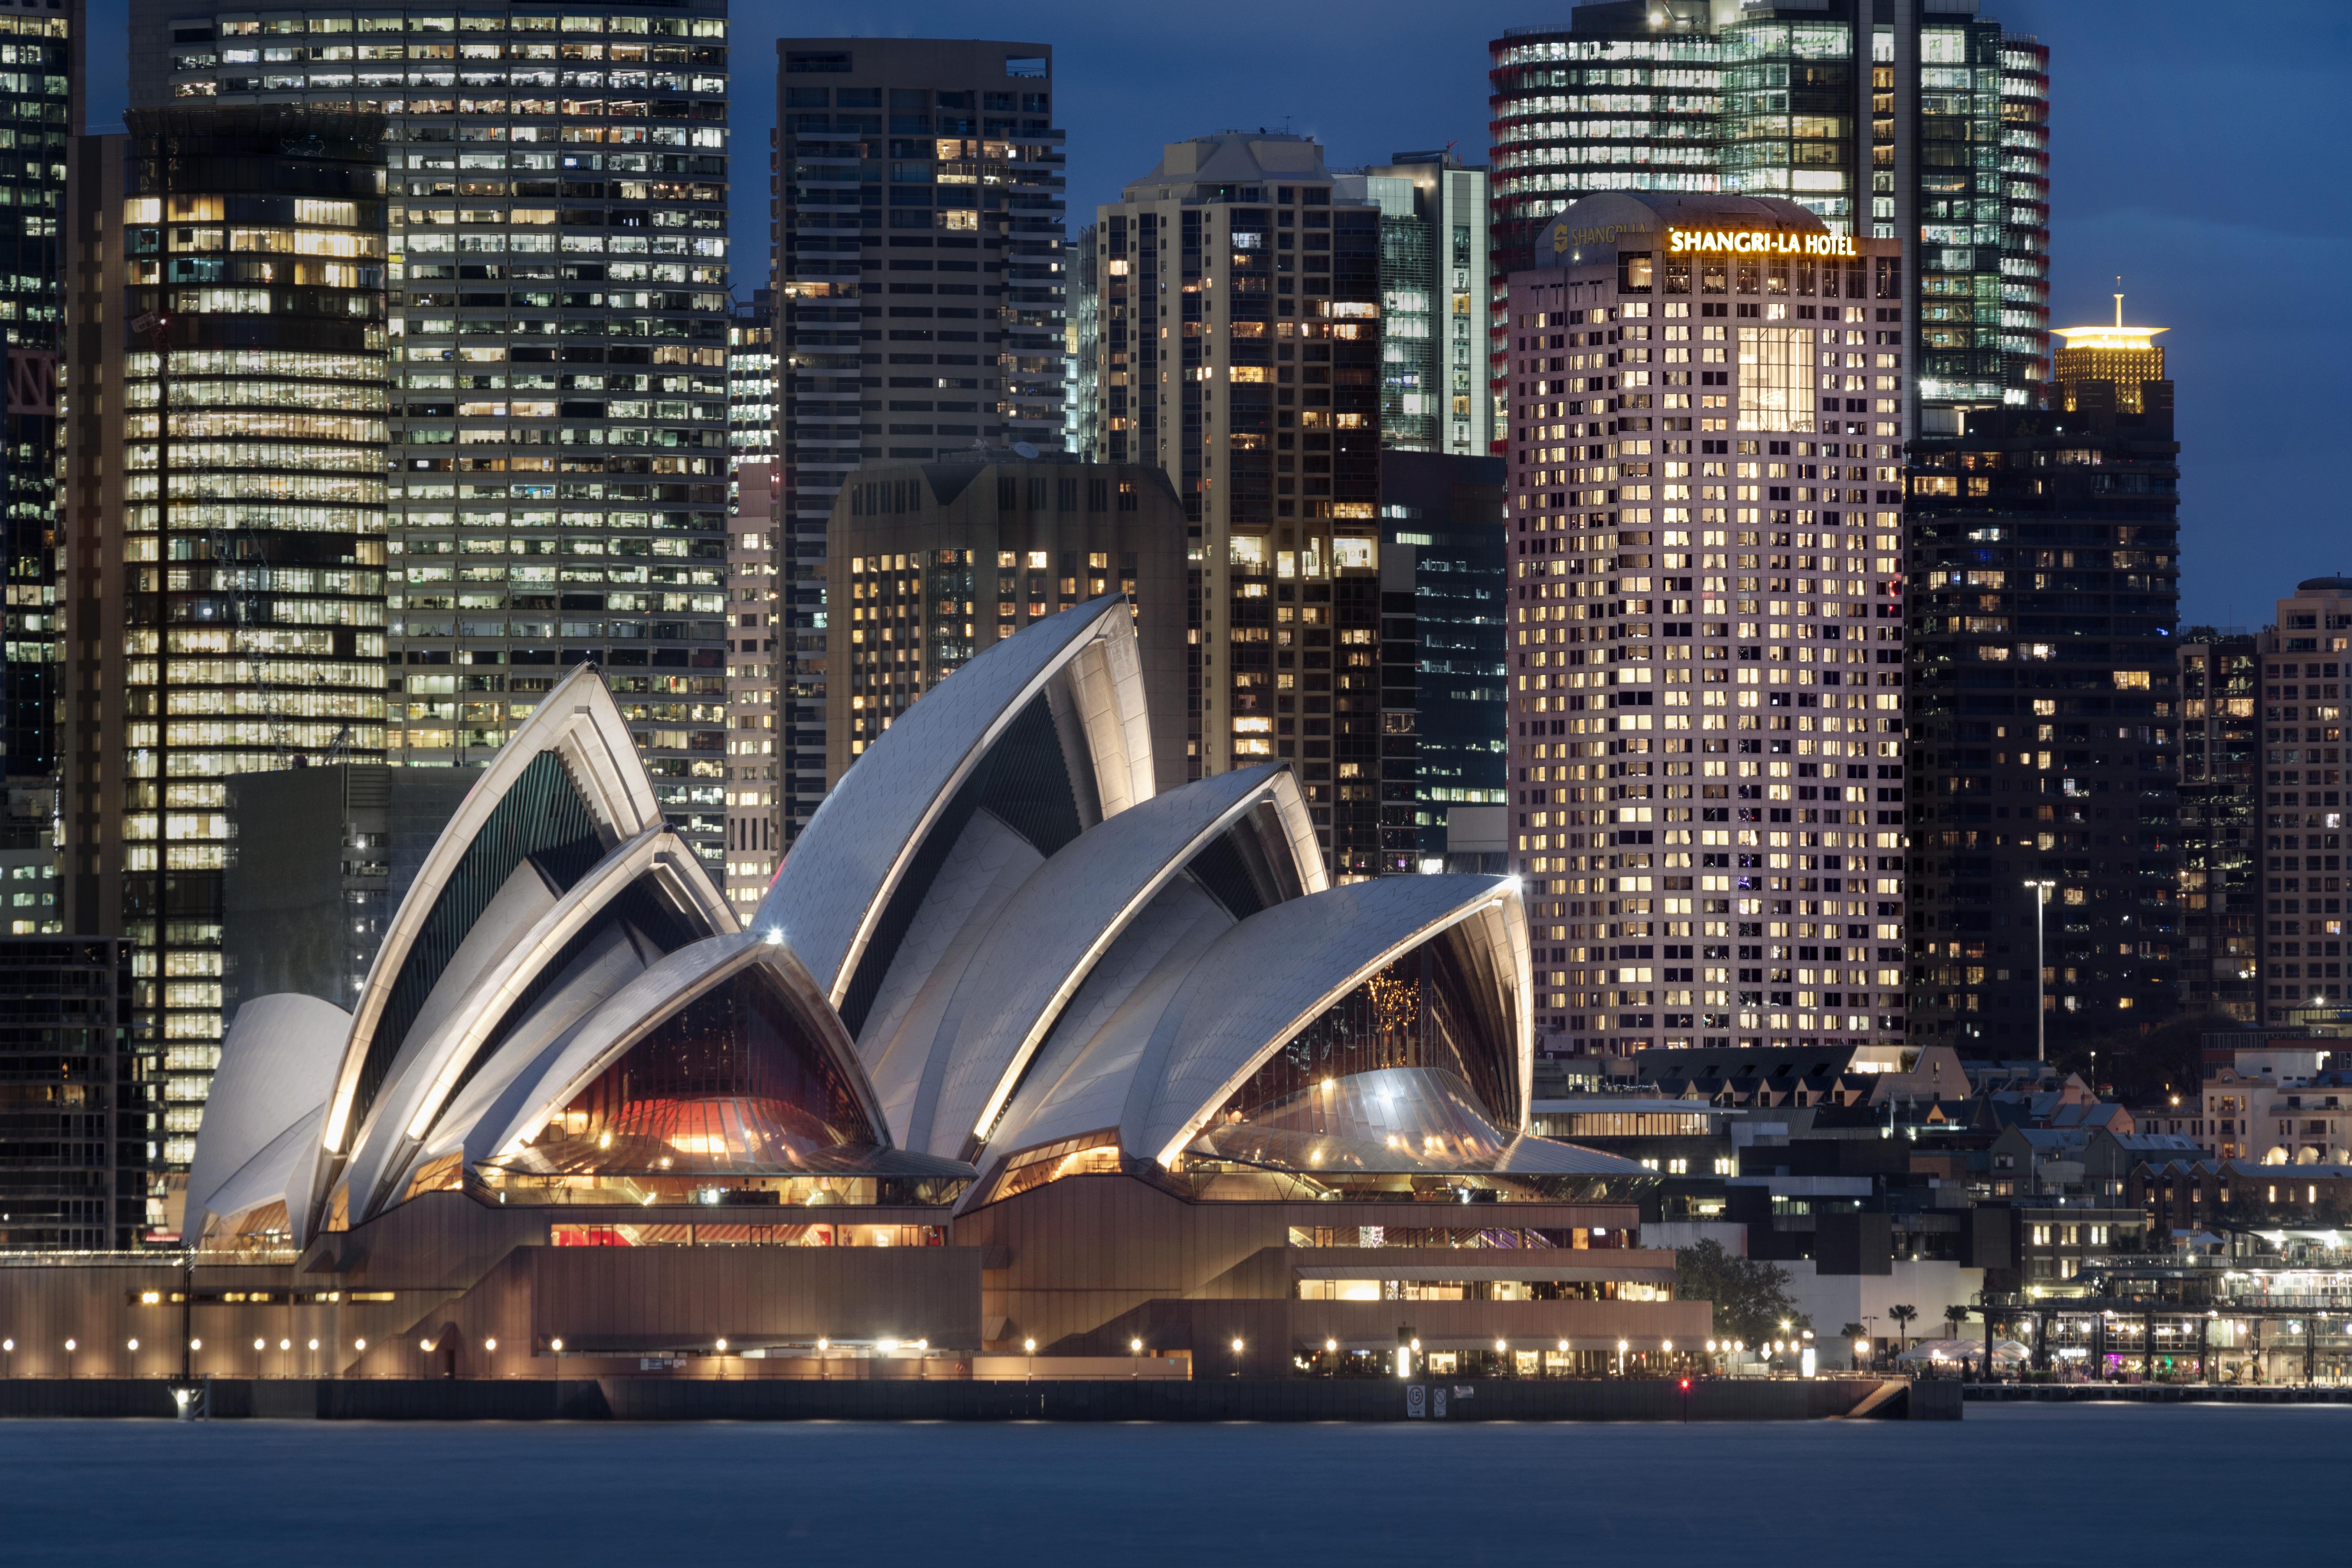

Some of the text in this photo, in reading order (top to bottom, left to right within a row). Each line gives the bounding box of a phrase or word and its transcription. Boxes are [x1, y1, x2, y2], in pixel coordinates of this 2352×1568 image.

[1572, 223, 1646, 246] SHANGA
[1671, 232, 1856, 255] SHANGRI-LA HOTEL
[1412, 1392, 1420, 1401] 15
